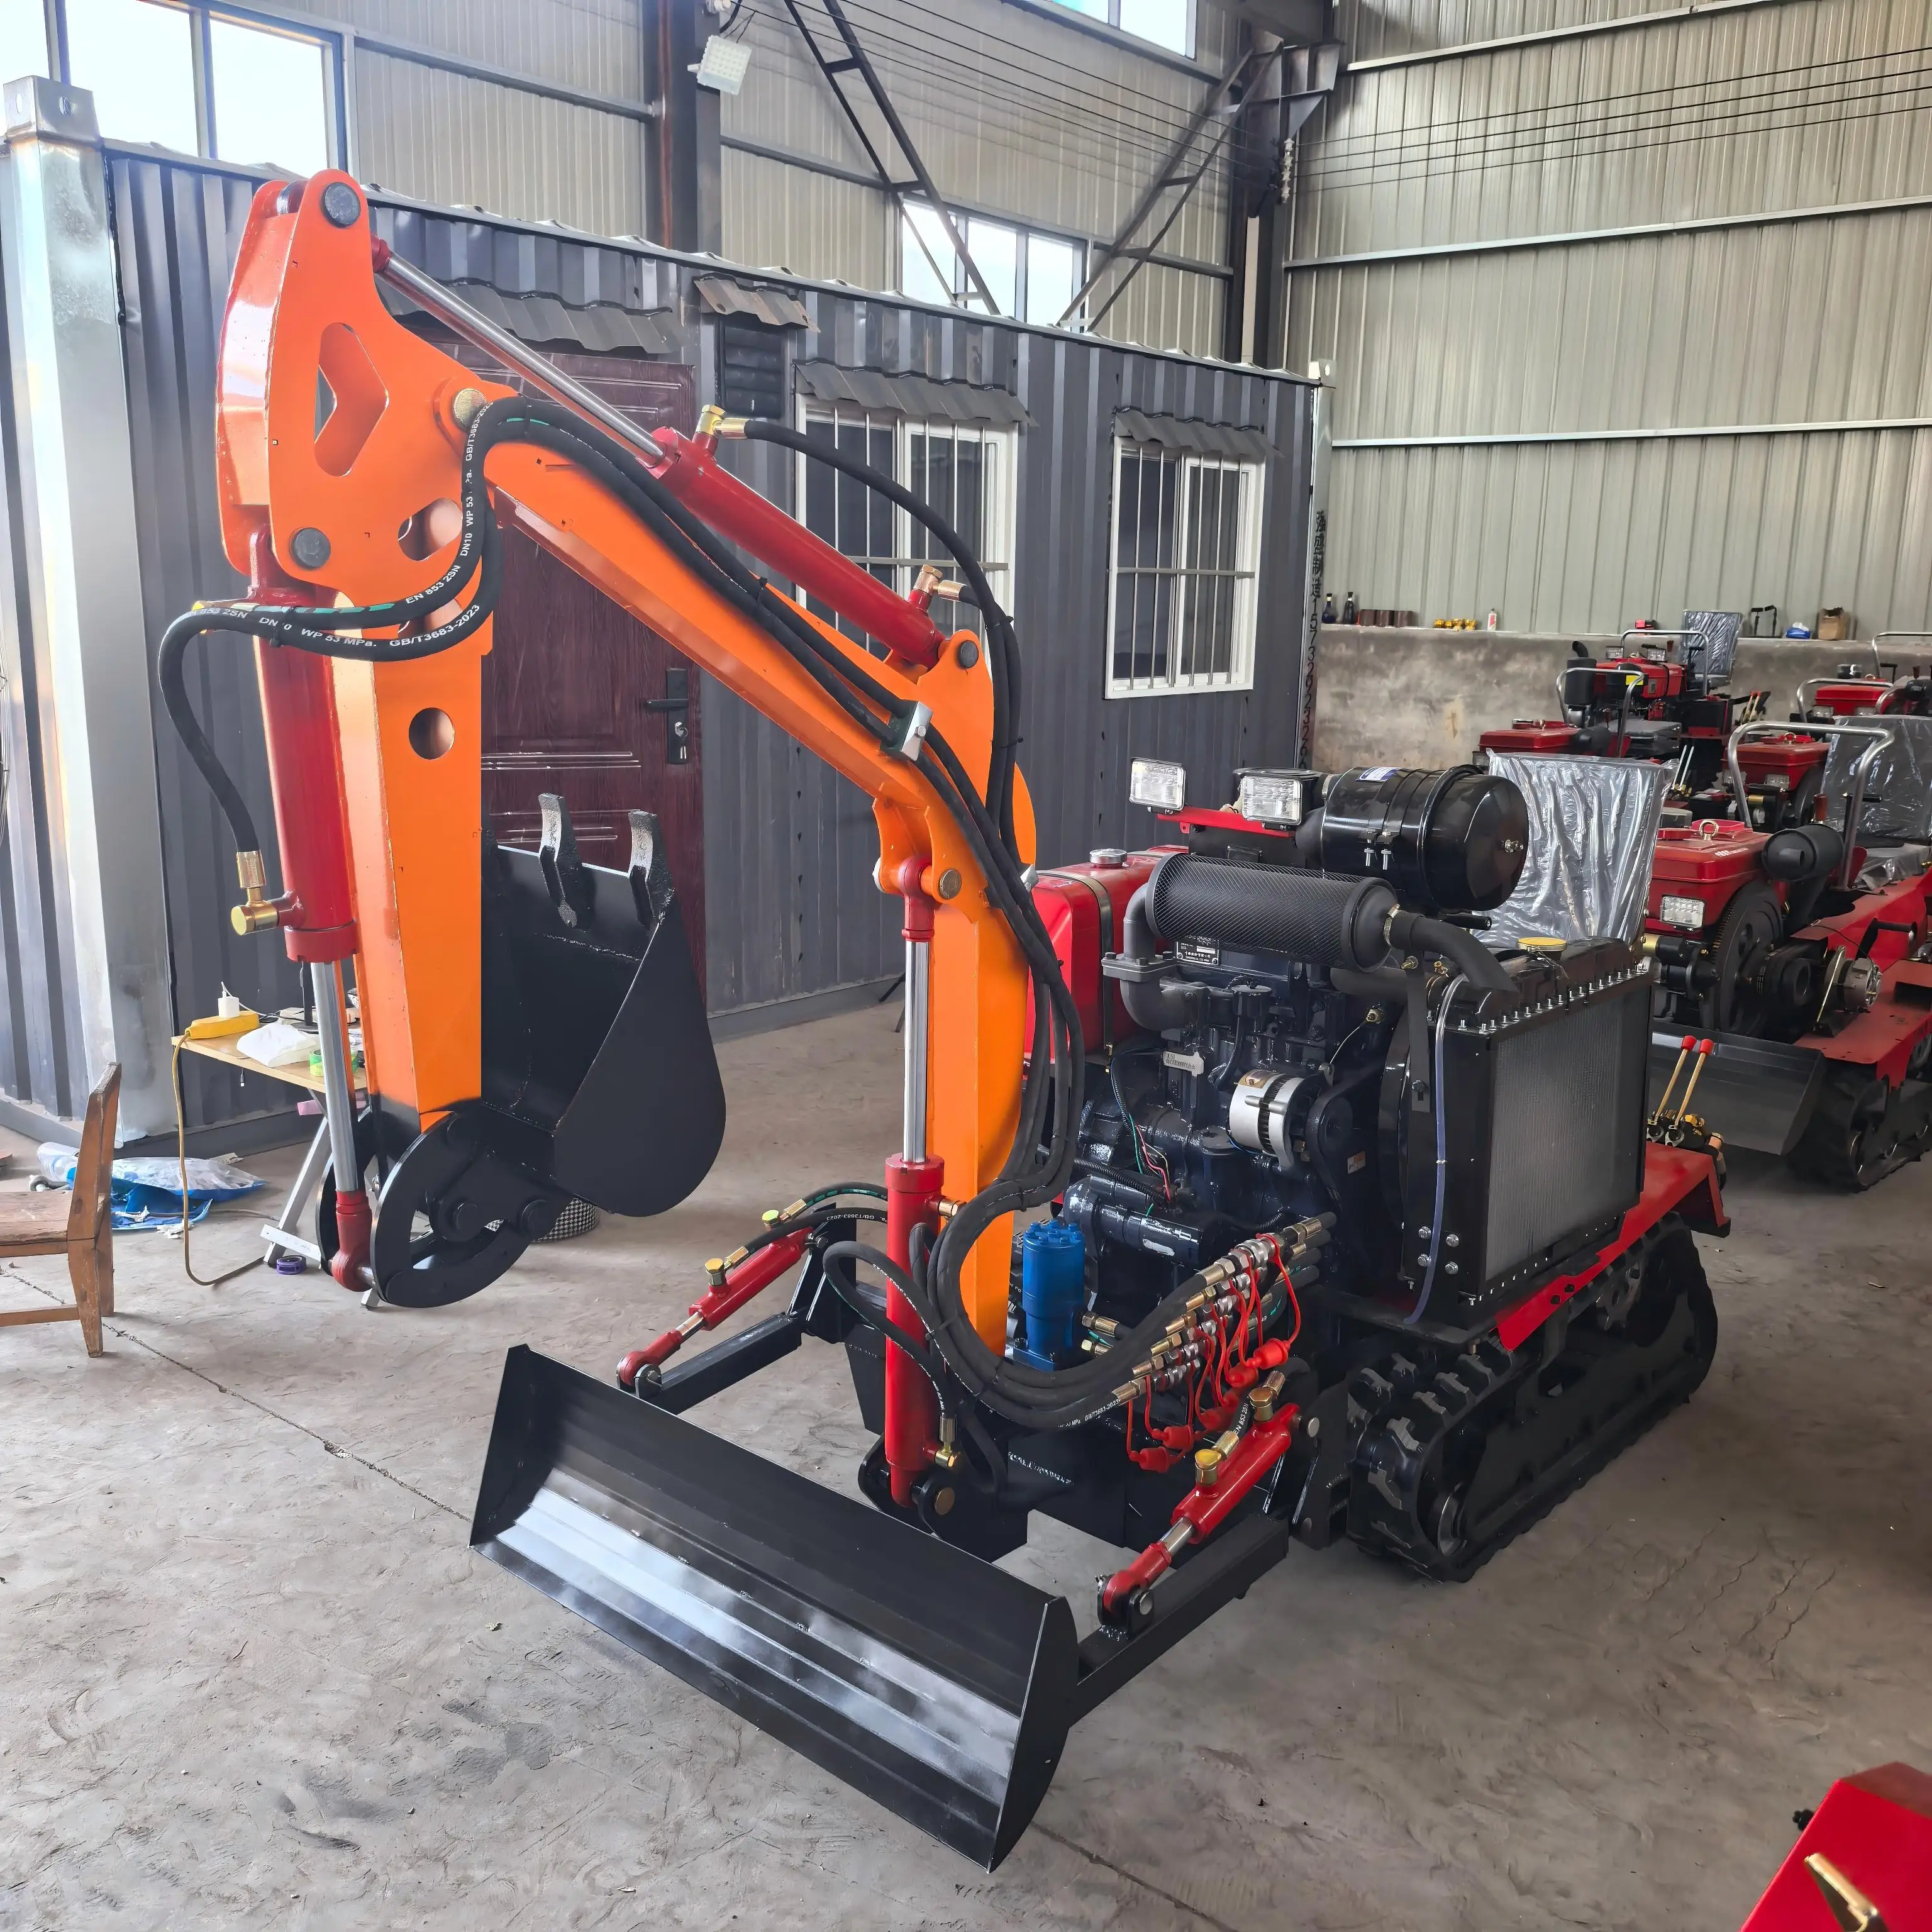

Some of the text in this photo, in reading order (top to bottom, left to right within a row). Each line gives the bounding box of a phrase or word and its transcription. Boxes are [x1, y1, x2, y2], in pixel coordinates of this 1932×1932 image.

[466, 496, 474, 508] 53
[466, 510, 474, 527] WP
[460, 533, 473, 557] DN10
[443, 565, 461, 582] 2SN
[425, 582, 444, 594] 853
[406, 593, 424, 604] EN
[222, 609, 248, 618] 2SN
[259, 617, 292, 630] DN0
[301, 628, 323, 638] WP
[343, 638, 377, 647] MPa.
[389, 604, 480, 647] GB/T3683-2023
[1233, 1425, 1241, 1435] EN
